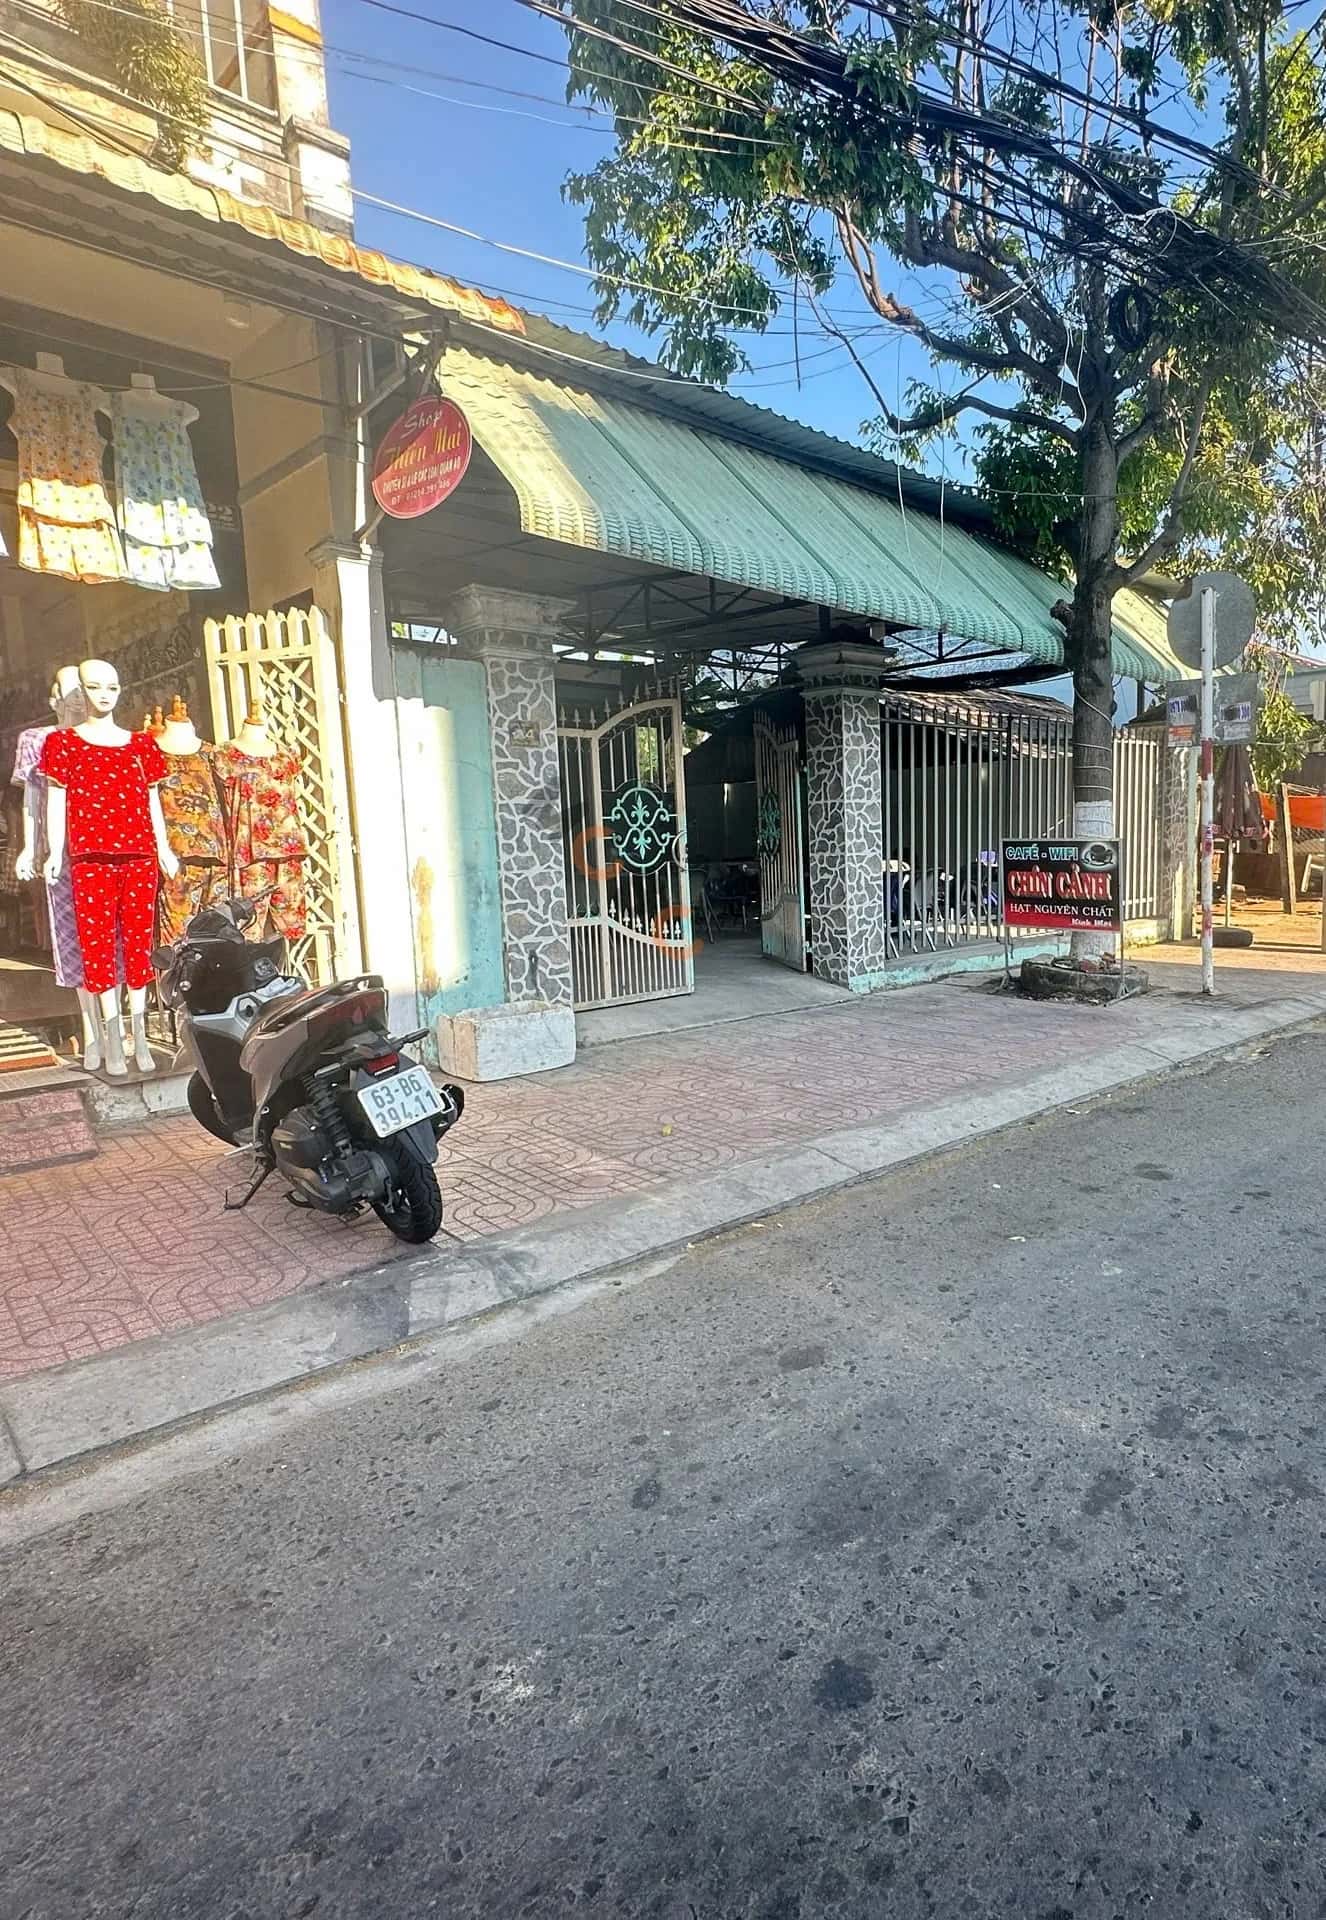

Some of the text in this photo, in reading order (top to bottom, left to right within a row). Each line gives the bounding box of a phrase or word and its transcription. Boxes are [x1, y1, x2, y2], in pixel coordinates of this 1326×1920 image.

[400, 411, 442, 439] Shop
[433, 421, 461, 455] Mai
[1006, 843, 1040, 861] CAFÉ
[1048, 847, 1079, 861] WIFI
[1010, 903, 1114, 918] HẠT NGUYÊN CHẤT
[371, 1074, 421, 1109] 63-B6
[376, 1090, 438, 1132] 394.11
